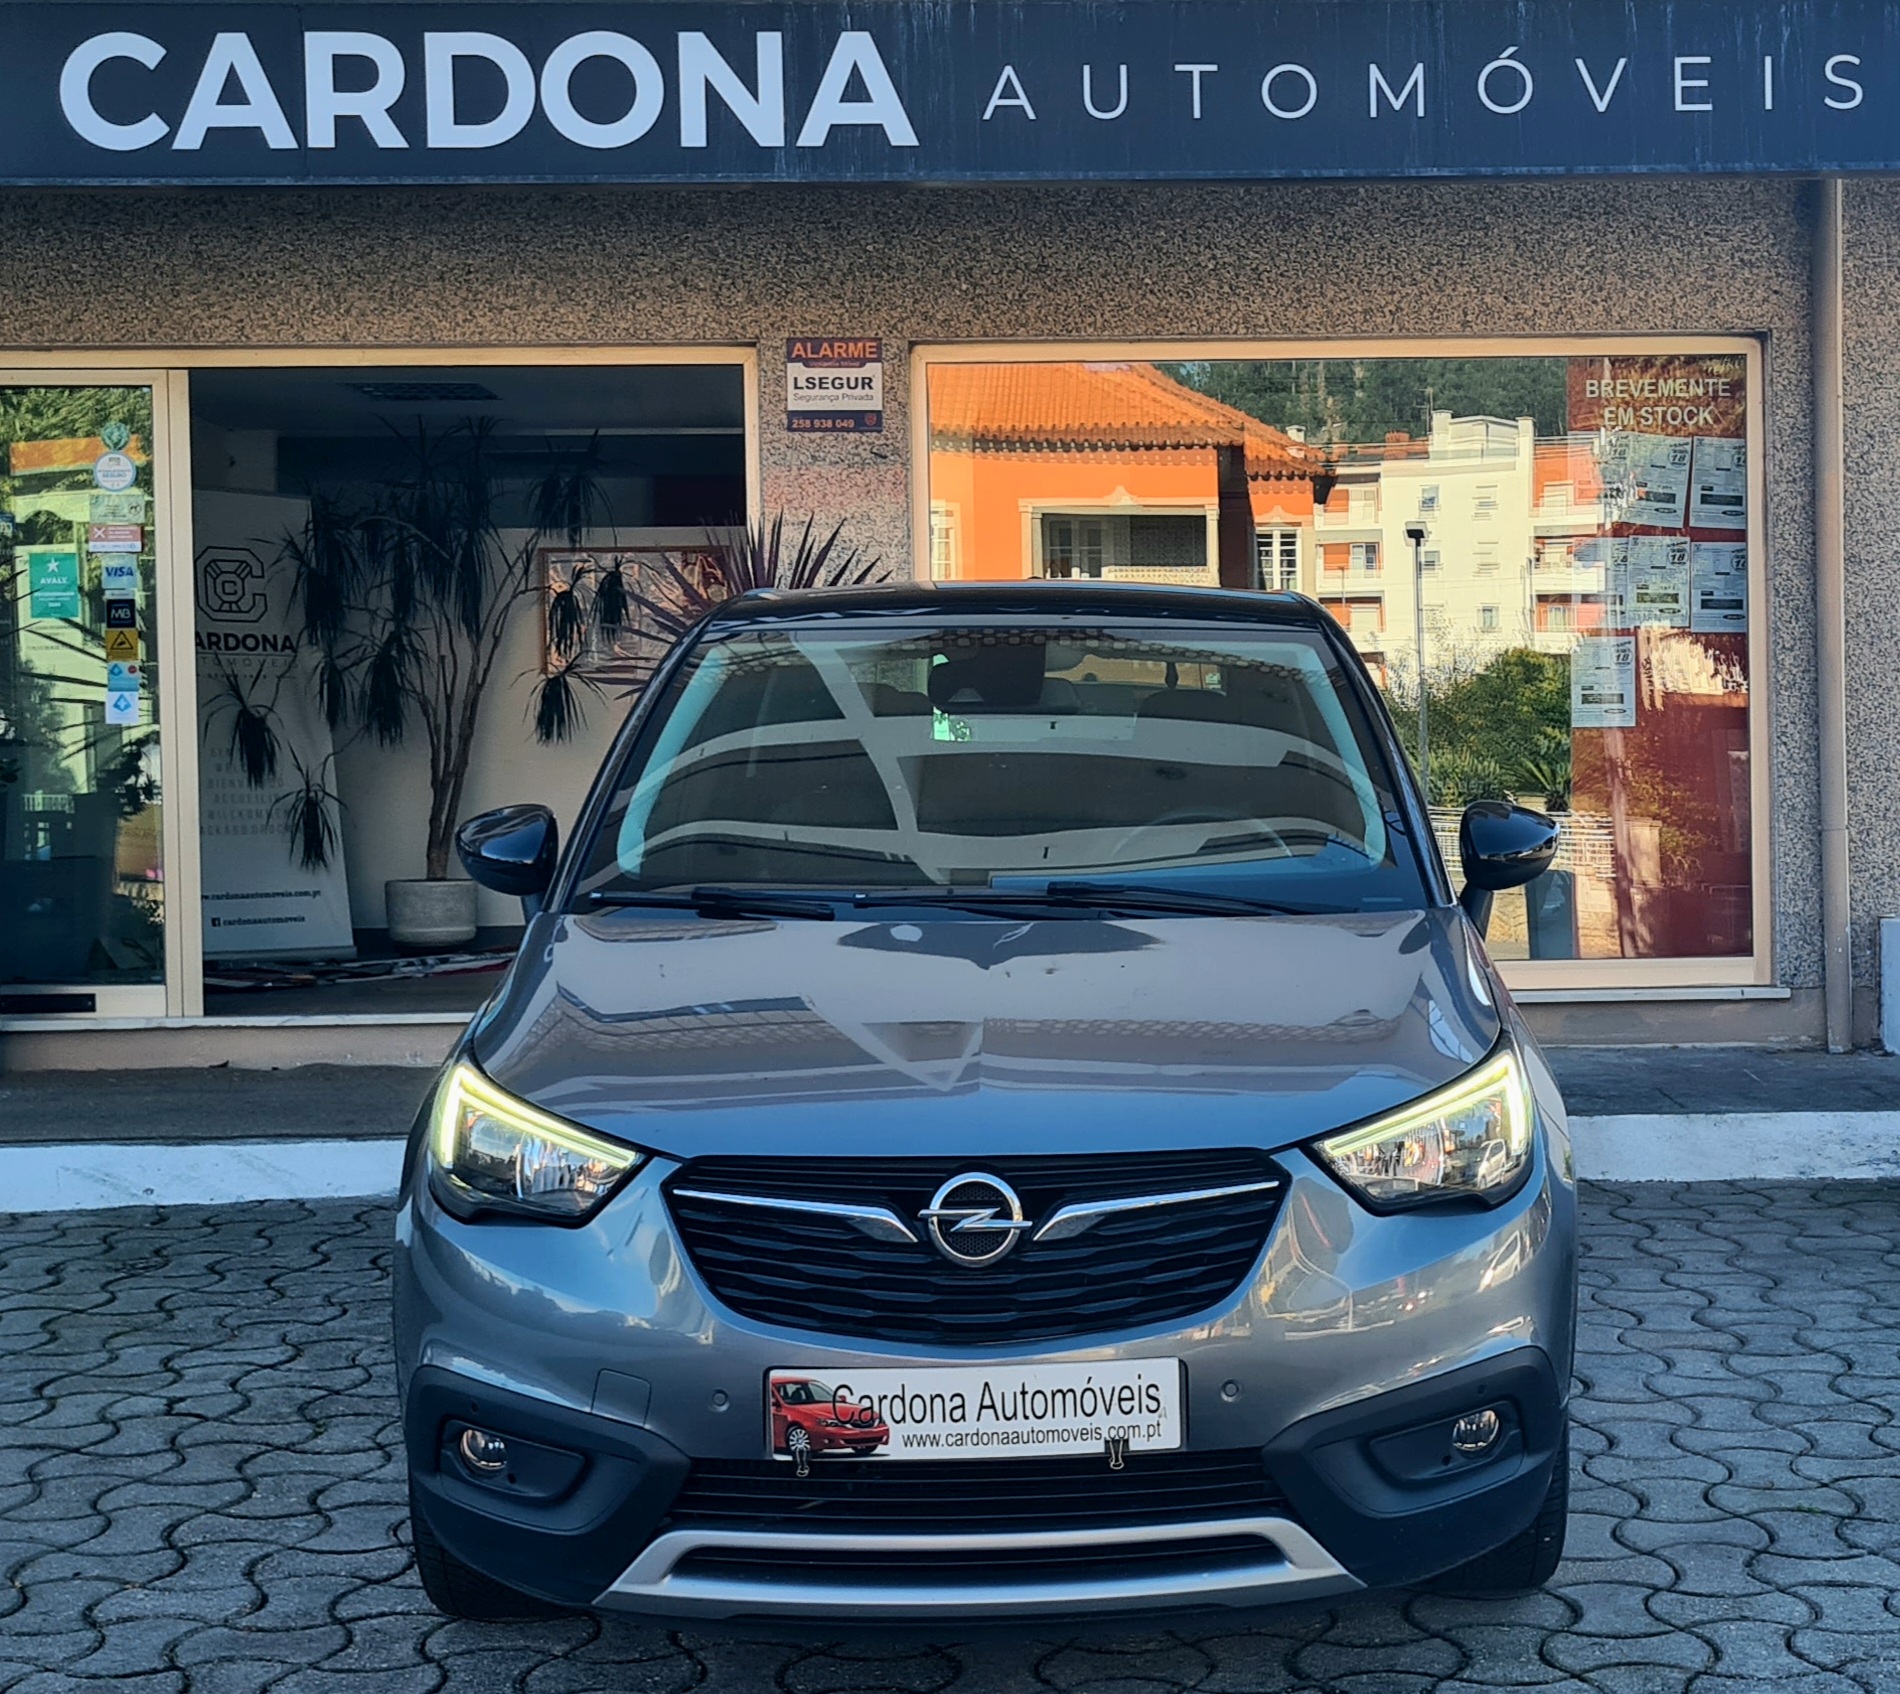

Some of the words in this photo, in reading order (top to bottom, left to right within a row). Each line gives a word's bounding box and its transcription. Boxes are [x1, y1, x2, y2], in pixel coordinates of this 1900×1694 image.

[59, 31, 919, 151] CARDONA
[982, 47, 1864, 119] AUTOMÓVEIS
[791, 342, 878, 358] ALARME
[793, 376, 874, 390] LSEGUR
[1585, 378, 1731, 398] BREVEMENTE
[793, 393, 839, 403] Segurança
[842, 393, 874, 401] Privada
[1604, 406, 1634, 426] EM
[1640, 406, 1715, 426] STOCK
[105, 566, 134, 577] VISA
[111, 608, 131, 619] MB
[195, 631, 296, 653] ARDONA
[831, 1384, 967, 1425] Cardona
[976, 1373, 1161, 1424] Automóveis
